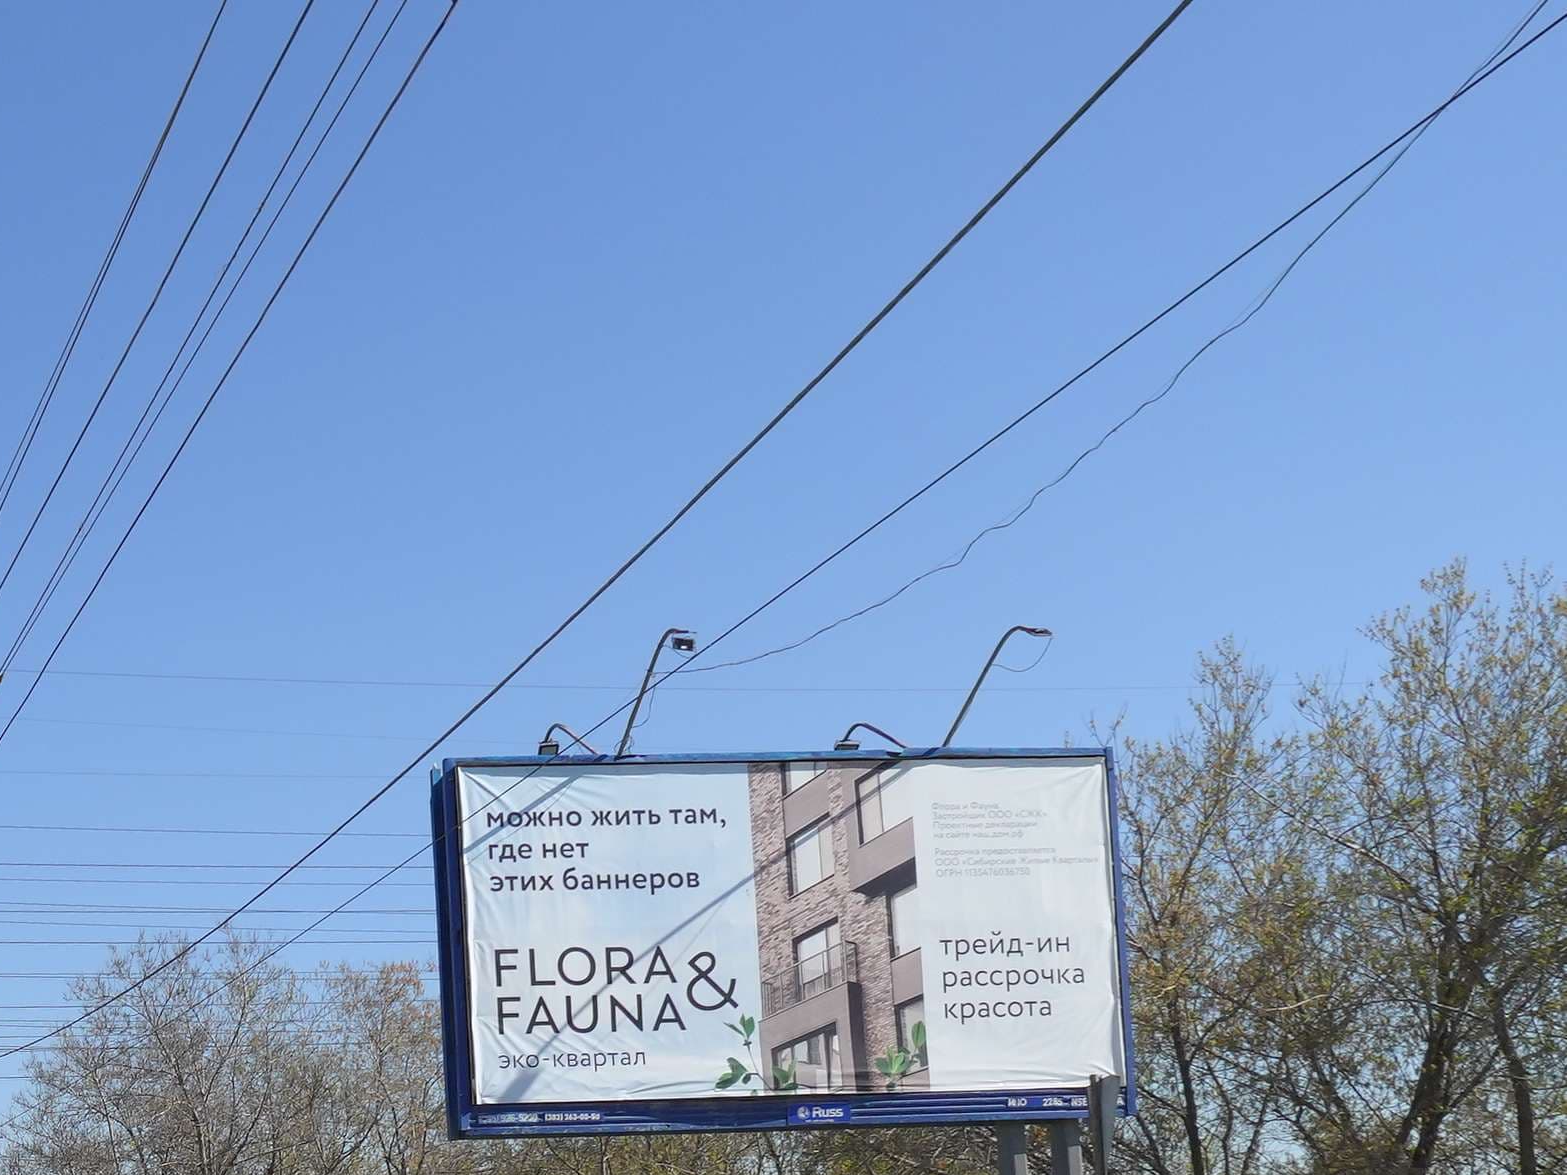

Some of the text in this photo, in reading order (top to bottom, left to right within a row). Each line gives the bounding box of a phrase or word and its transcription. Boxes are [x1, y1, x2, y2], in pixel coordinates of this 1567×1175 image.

[486, 807, 727, 828] можно жить там,
[488, 841, 589, 863] где нет
[489, 867, 700, 895] этих баннеров
[939, 931, 1070, 961] трейд-ин
[494, 945, 678, 987] FLORA
[942, 968, 1085, 993] рассрочка
[497, 993, 688, 1035] FAUNA
[944, 1000, 1052, 1025] красота
[498, 1051, 646, 1073] эко-квартал
[812, 1106, 844, 1118] Russ
